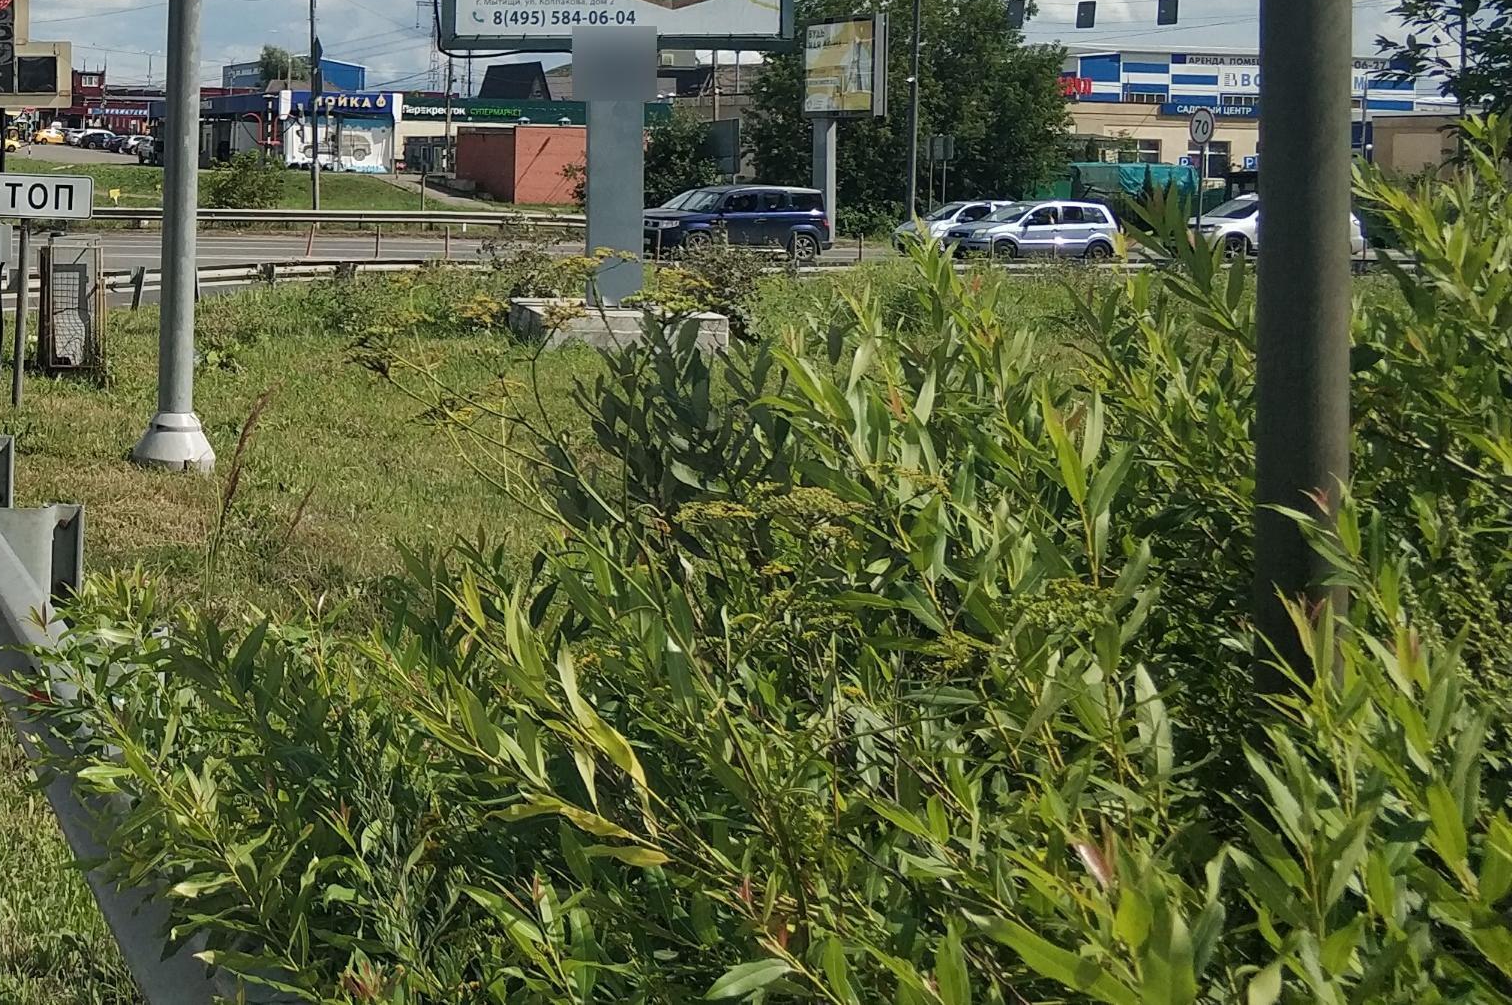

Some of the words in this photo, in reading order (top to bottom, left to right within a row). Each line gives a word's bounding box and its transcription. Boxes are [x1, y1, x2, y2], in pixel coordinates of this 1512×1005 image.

[493, 10, 546, 27] 8(495)
[551, 10, 636, 25] 584-06-04
[1189, 56, 1225, 65] АРЕНДА
[1224, 106, 1252, 115] ЦЕНТР
[1194, 119, 1209, 135] 70
